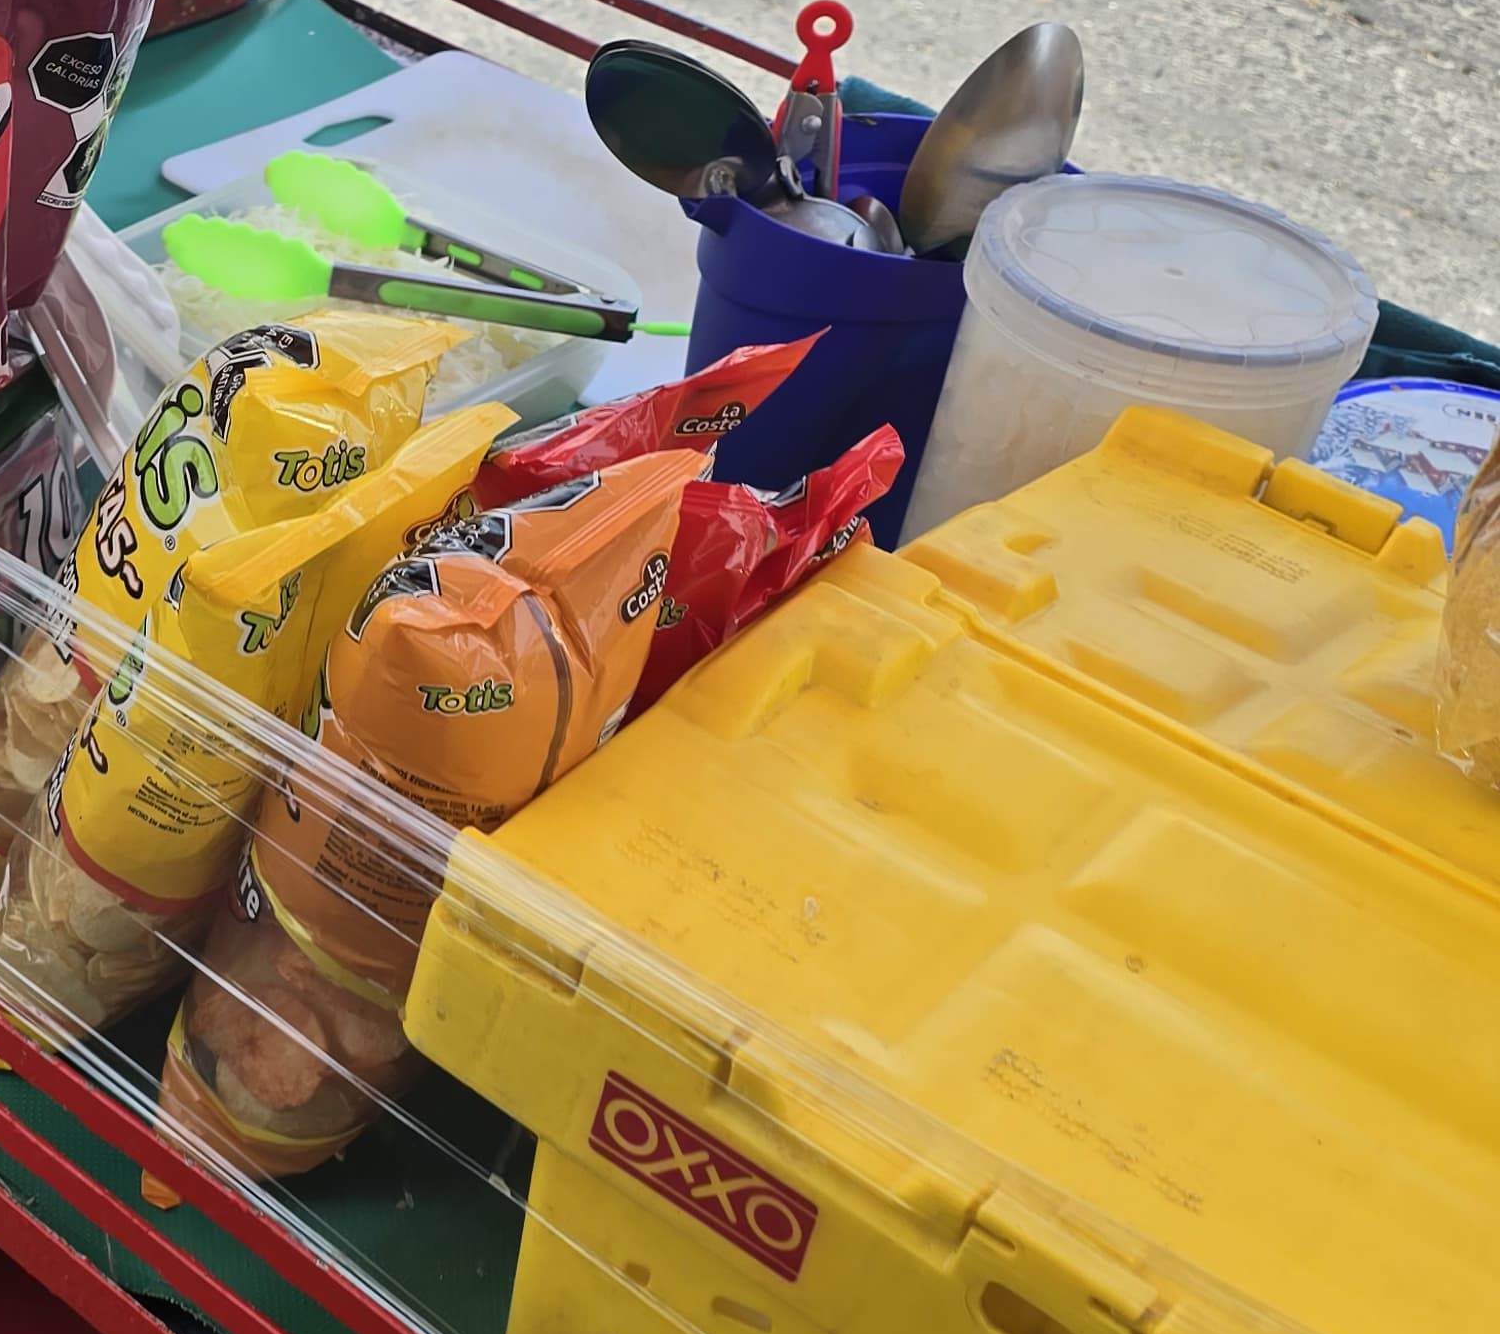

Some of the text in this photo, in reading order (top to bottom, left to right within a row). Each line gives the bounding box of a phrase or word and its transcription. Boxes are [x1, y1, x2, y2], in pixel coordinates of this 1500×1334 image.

[45, 62, 101, 90] CALORIAS
[59, 53, 103, 76] EXCESO
[721, 404, 740, 419] La
[680, 417, 743, 433] Coste
[275, 439, 367, 492] Totis
[647, 556, 666, 581] La
[418, 677, 515, 715] Totis
[603, 1098, 803, 1252] OXXO
